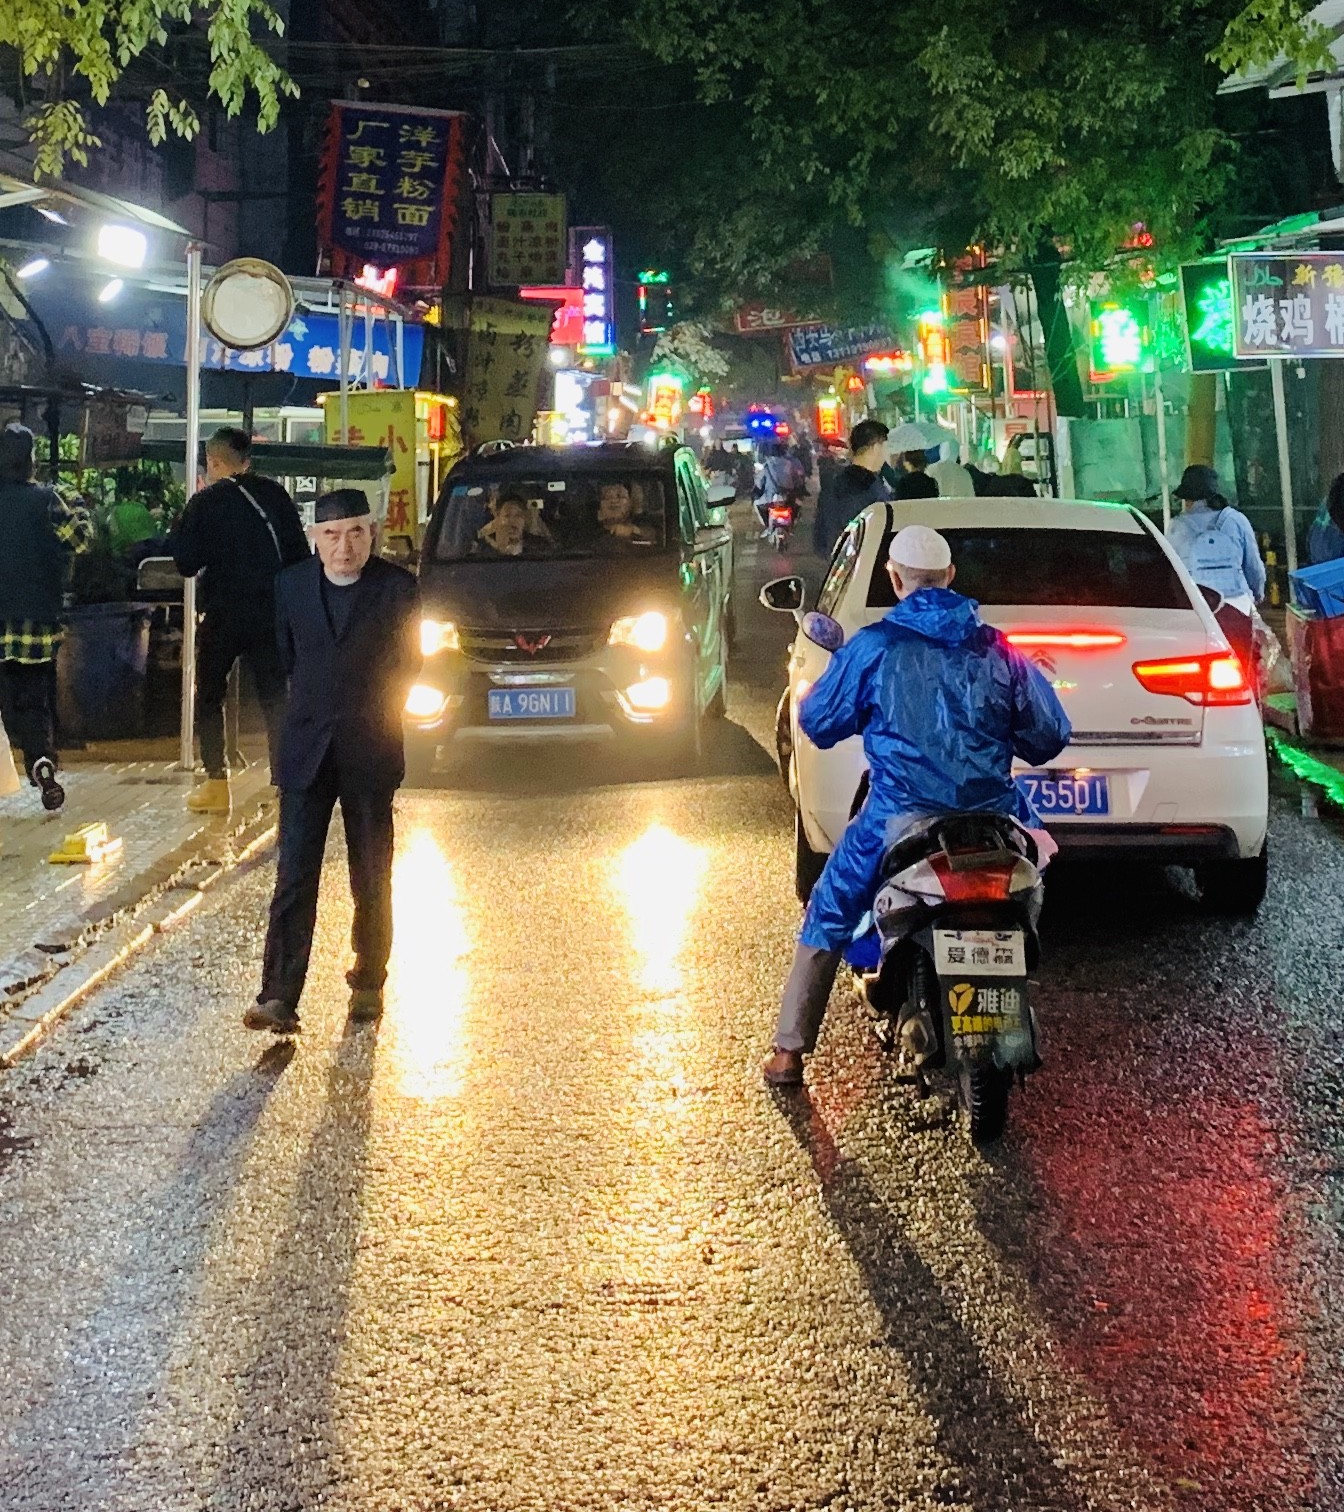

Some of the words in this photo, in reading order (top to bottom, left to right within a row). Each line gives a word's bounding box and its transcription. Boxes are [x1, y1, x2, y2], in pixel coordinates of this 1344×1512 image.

[341, 120, 390, 223] 厂家直销
[393, 124, 441, 226] 洋芋粉面
[1242, 293, 1315, 346] 烧鸡
[518, 693, 570, 713] 9GN11
[977, 988, 1021, 1014] 雅迪
